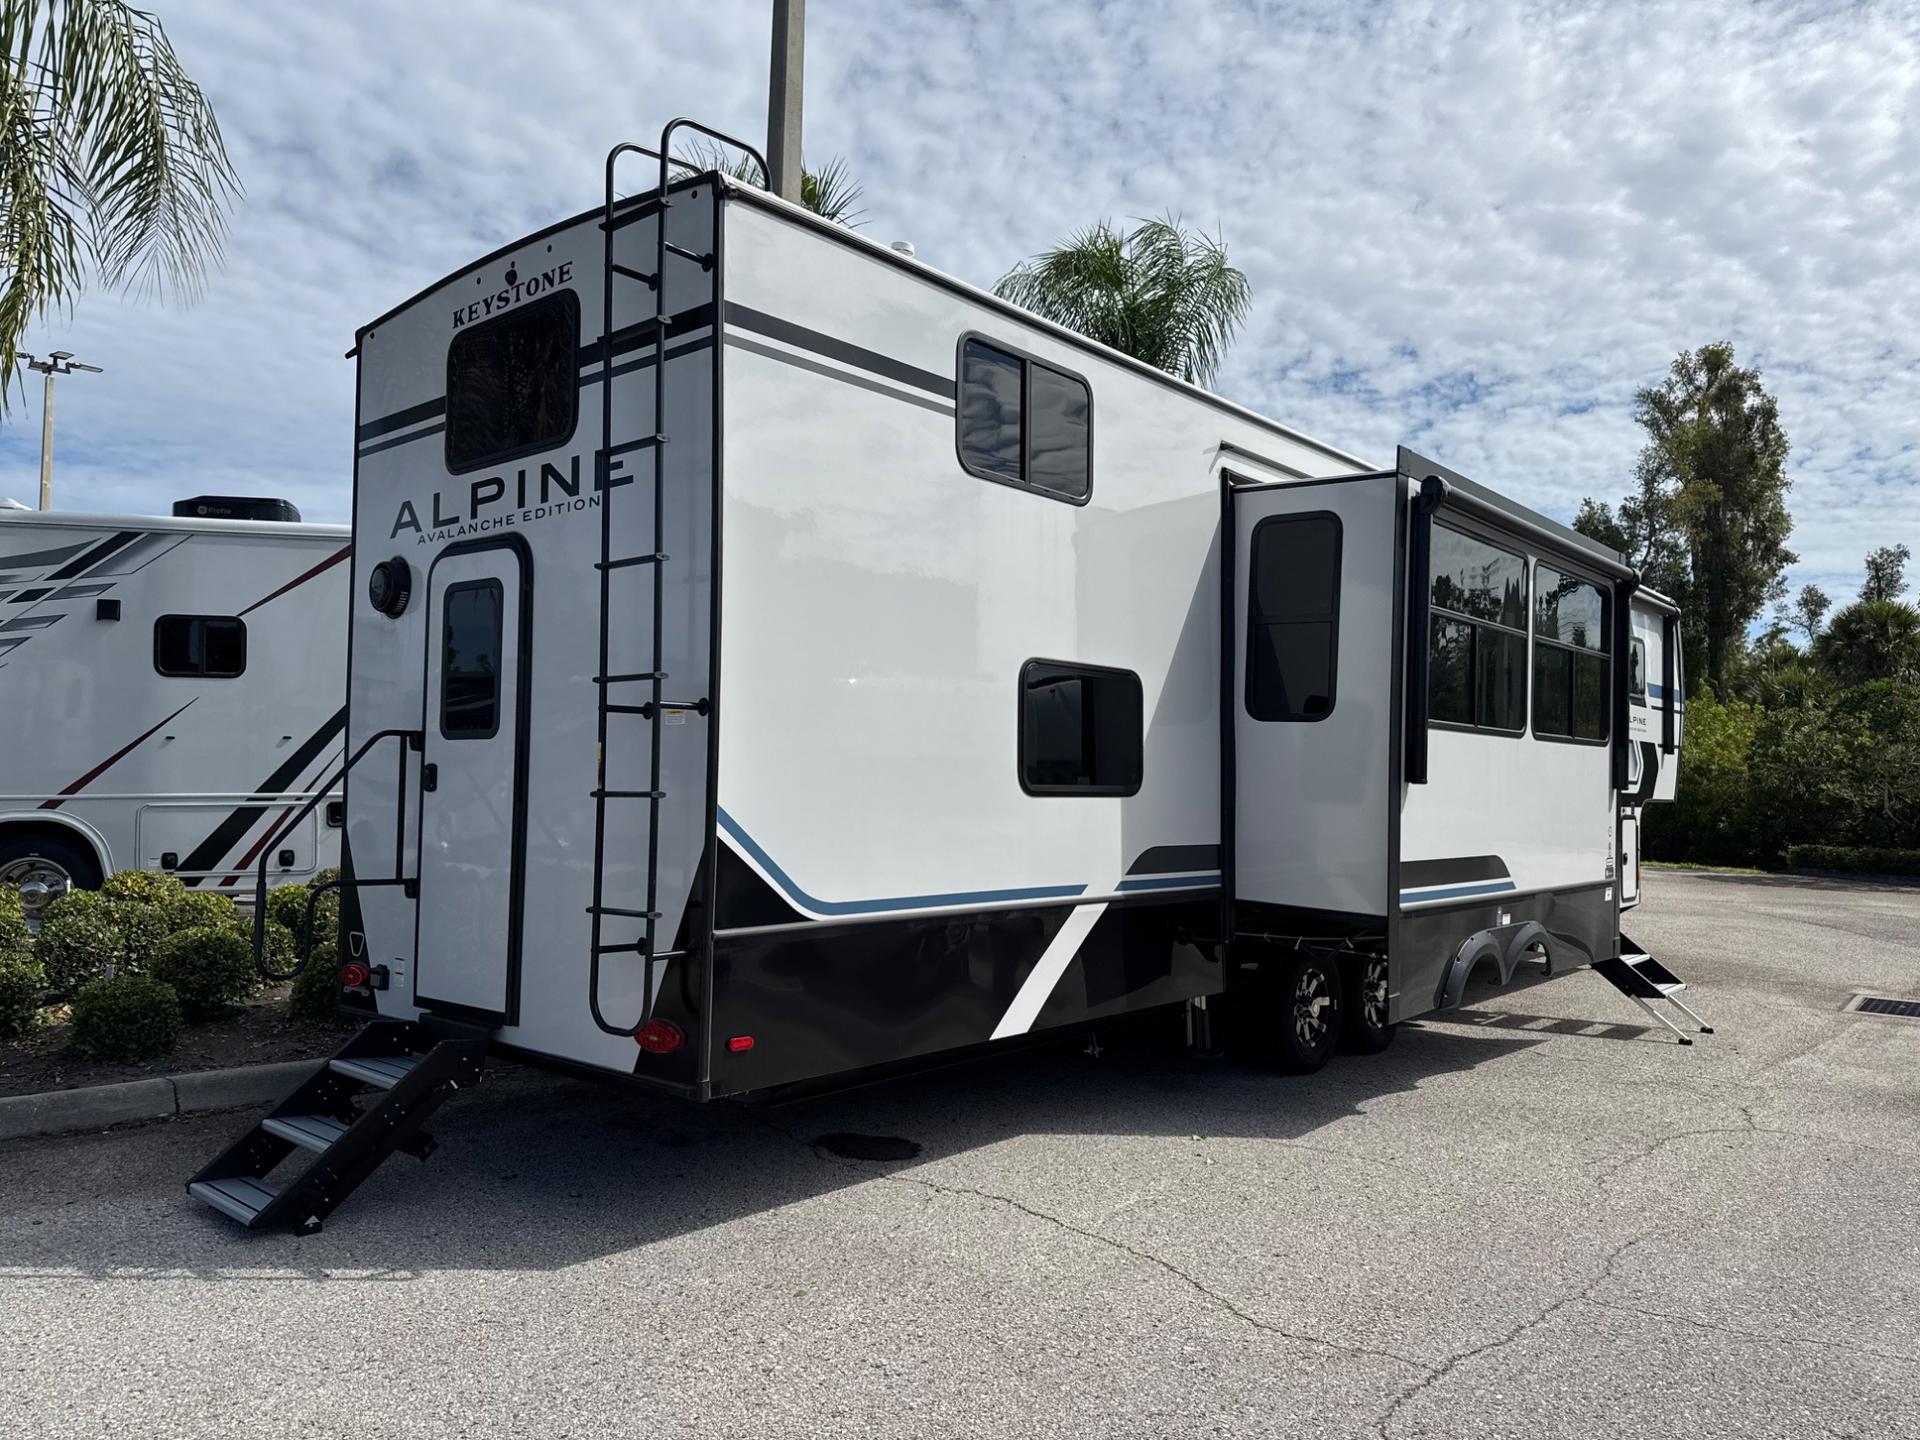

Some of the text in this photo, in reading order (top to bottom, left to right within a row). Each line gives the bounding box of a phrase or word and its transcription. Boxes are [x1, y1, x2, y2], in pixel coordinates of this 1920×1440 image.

[452, 261, 573, 330] KEYSTONE
[390, 450, 634, 540] ALPINE
[417, 494, 602, 545] AVALANCHE EDITION
